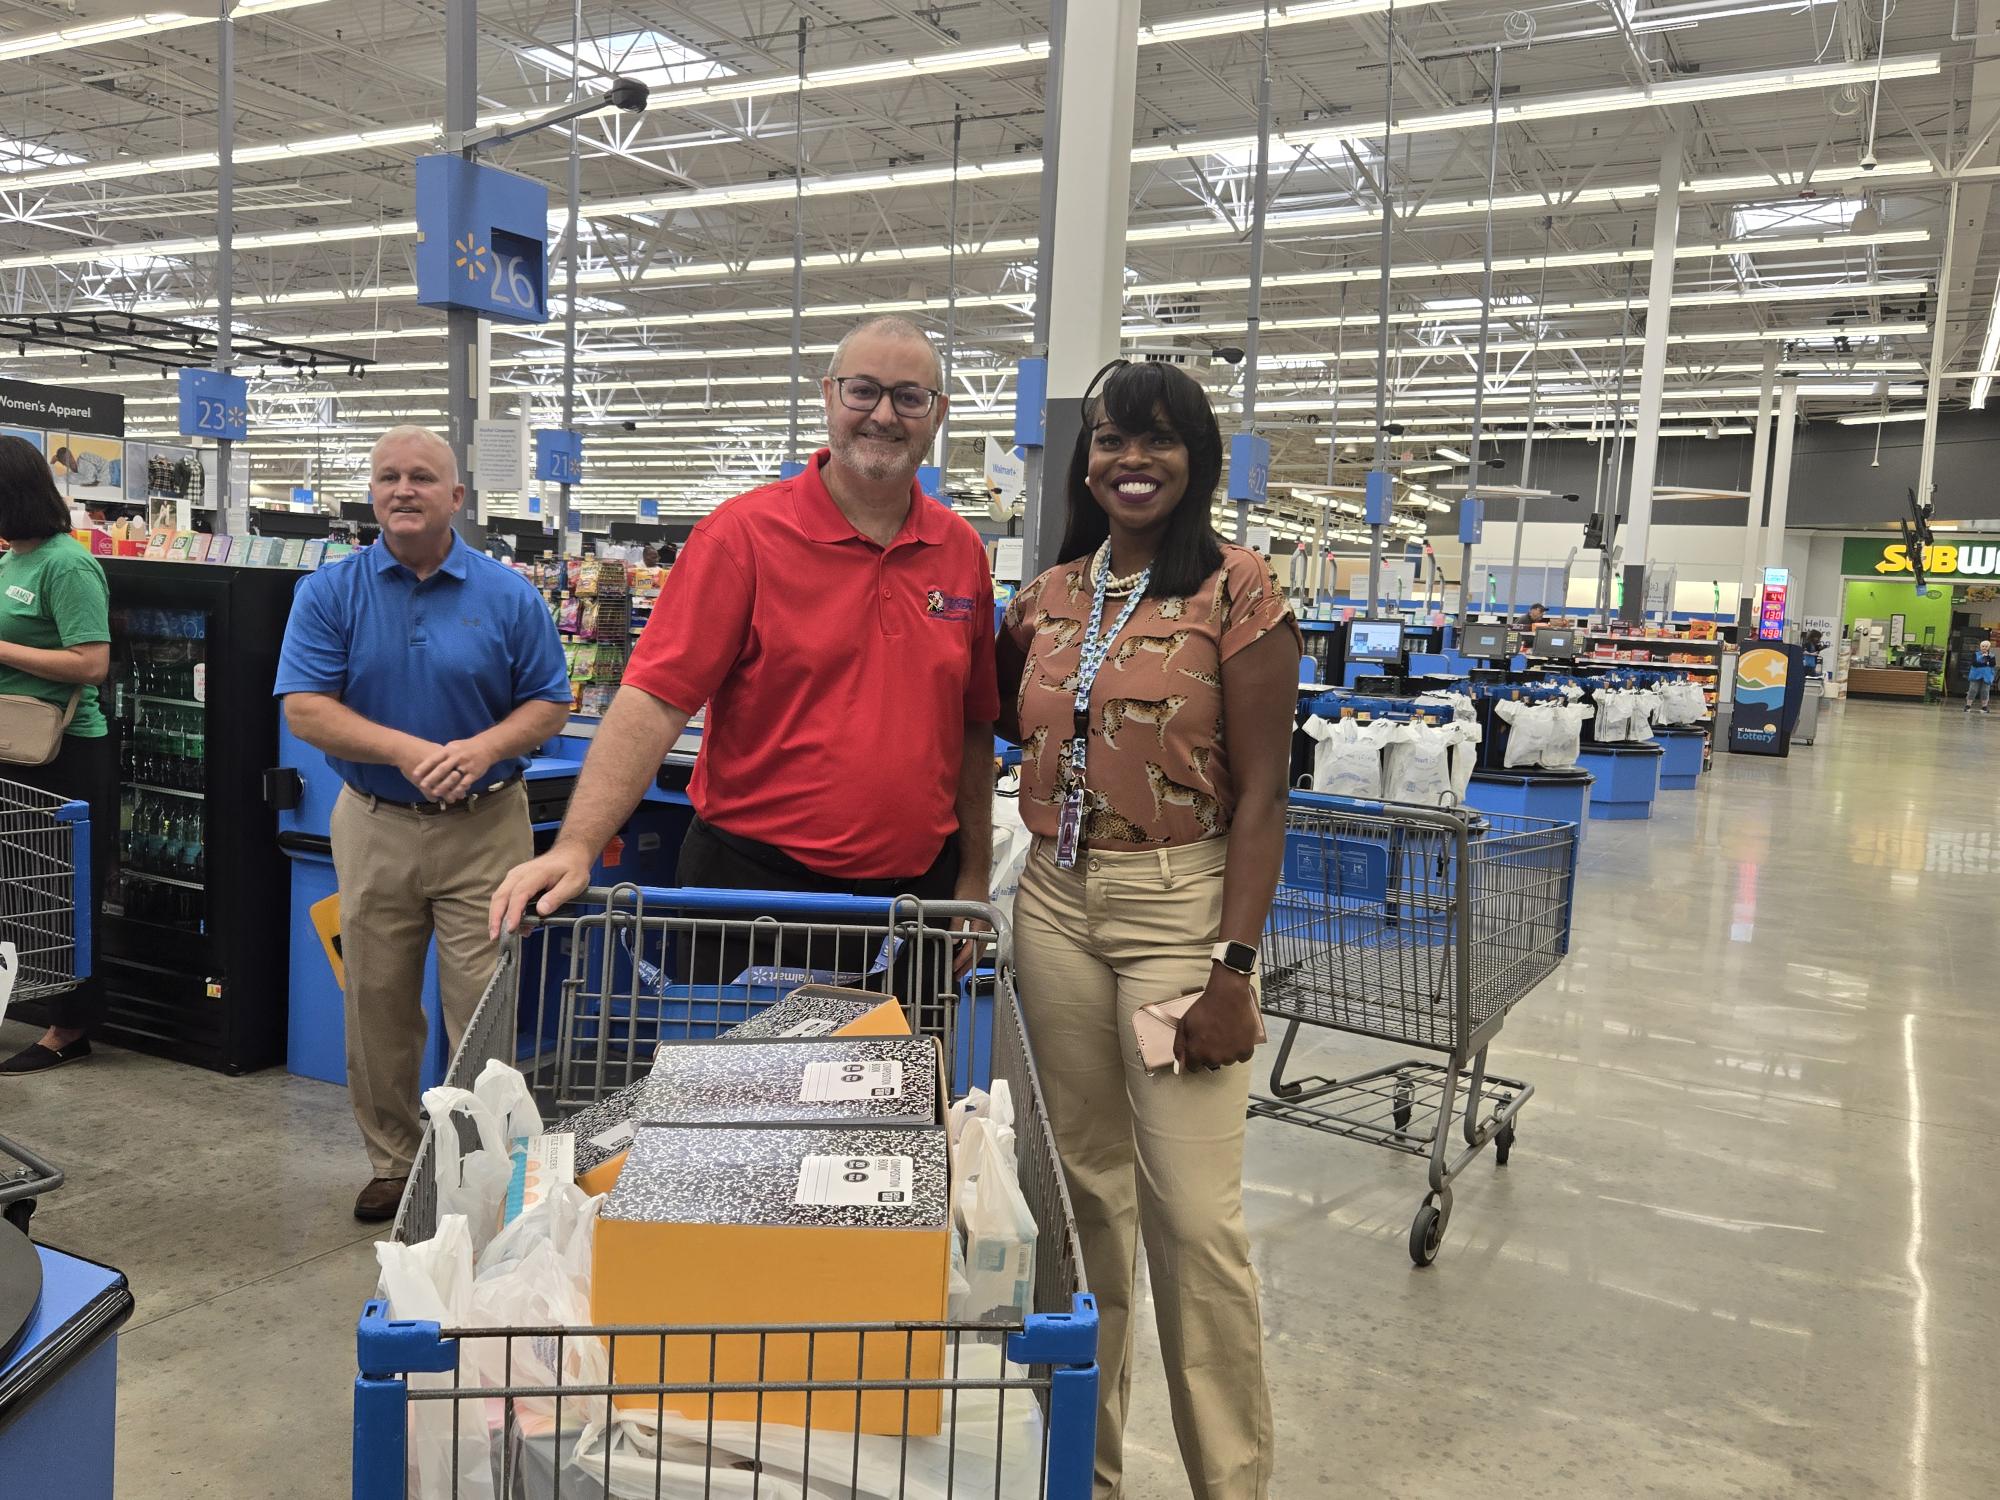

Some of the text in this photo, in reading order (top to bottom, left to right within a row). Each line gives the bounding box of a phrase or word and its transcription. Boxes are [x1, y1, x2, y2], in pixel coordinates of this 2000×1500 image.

[491, 251, 535, 309] 26
[0, 395, 91, 418] Women's Apparel
[199, 400, 225, 430] 23
[551, 454, 568, 476] 21
[1875, 544, 2000, 574] SUBW
[1737, 732, 1775, 743] Lottery
[769, 971, 815, 984] Walmart
